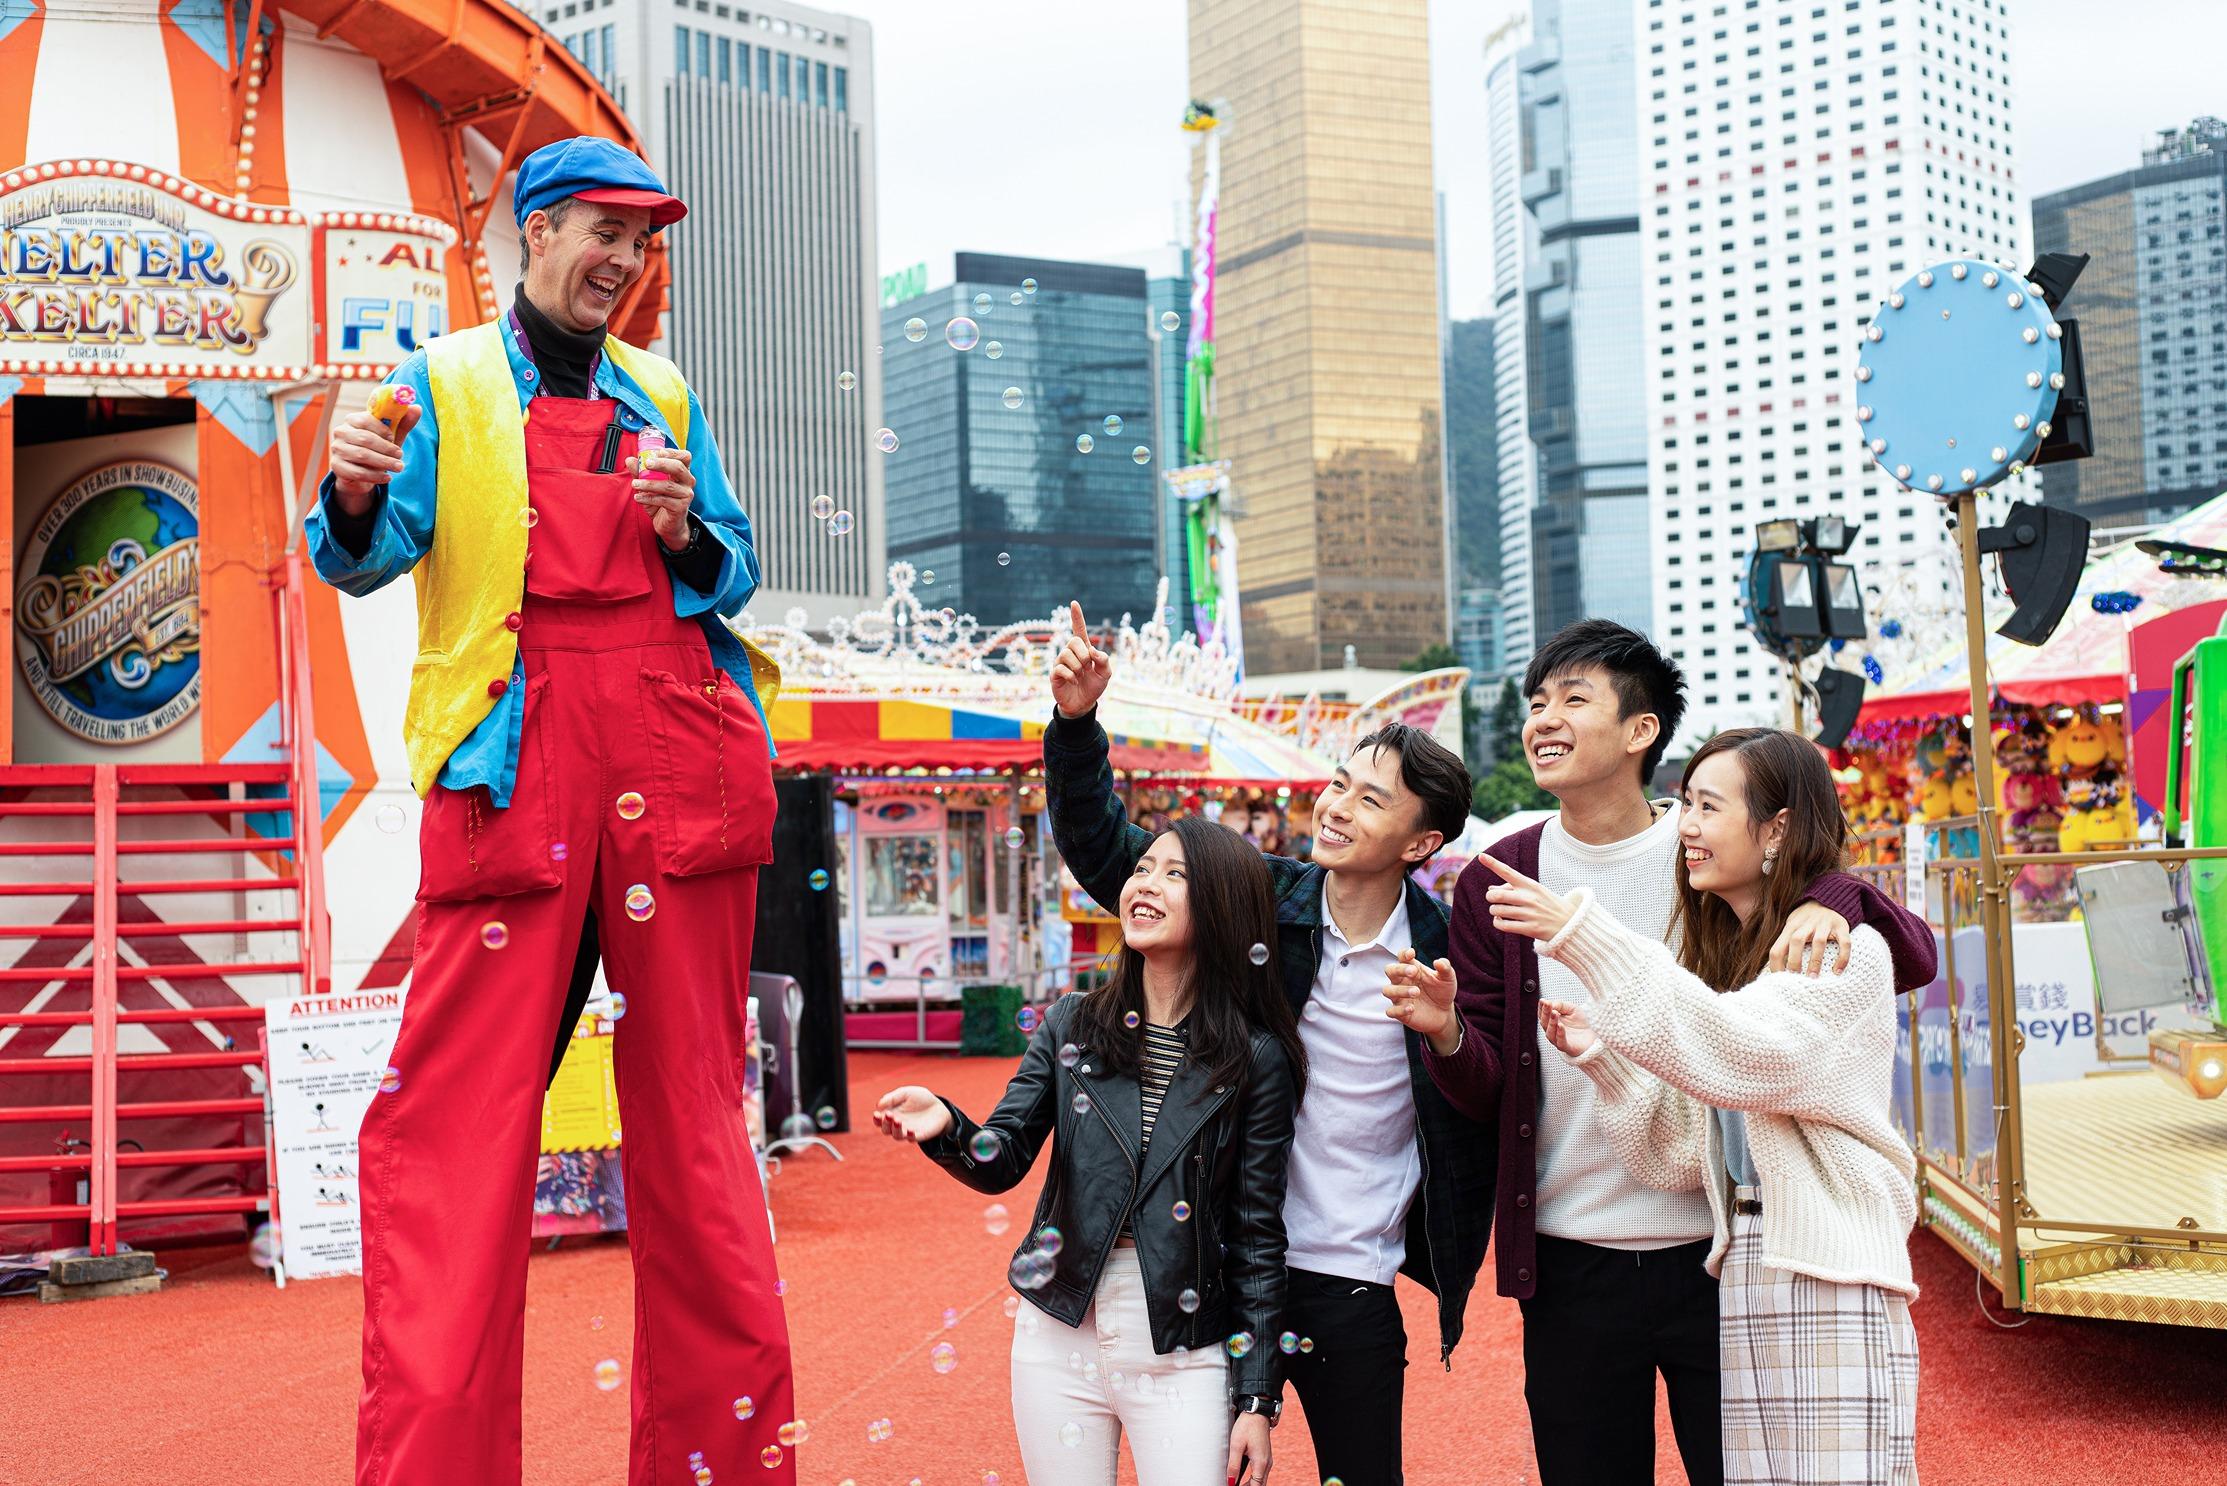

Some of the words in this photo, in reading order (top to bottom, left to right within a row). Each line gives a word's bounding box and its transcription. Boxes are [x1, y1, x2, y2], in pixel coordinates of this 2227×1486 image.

[3, 188, 53, 229] HENRY
[53, 182, 153, 219] CHIPPERFIELD
[61, 216, 93, 226] PROUDLY
[95, 217, 132, 226] PRESENTS
[0, 228, 234, 290] ELTER
[68, 347, 98, 359] CIRCA
[37, 508, 65, 544] OVER
[61, 488, 83, 512] 300
[81, 467, 117, 496] YEARS
[119, 465, 132, 482] IN
[25, 657, 43, 684] AND
[37, 682, 61, 714] STILL
[63, 706, 125, 739] TRAVELLING
[129, 721, 150, 737] THE
[153, 697, 189, 729] WORLD
[291, 994, 398, 1016] ATTENTION
[1979, 1009, 2157, 1046] eyBack
